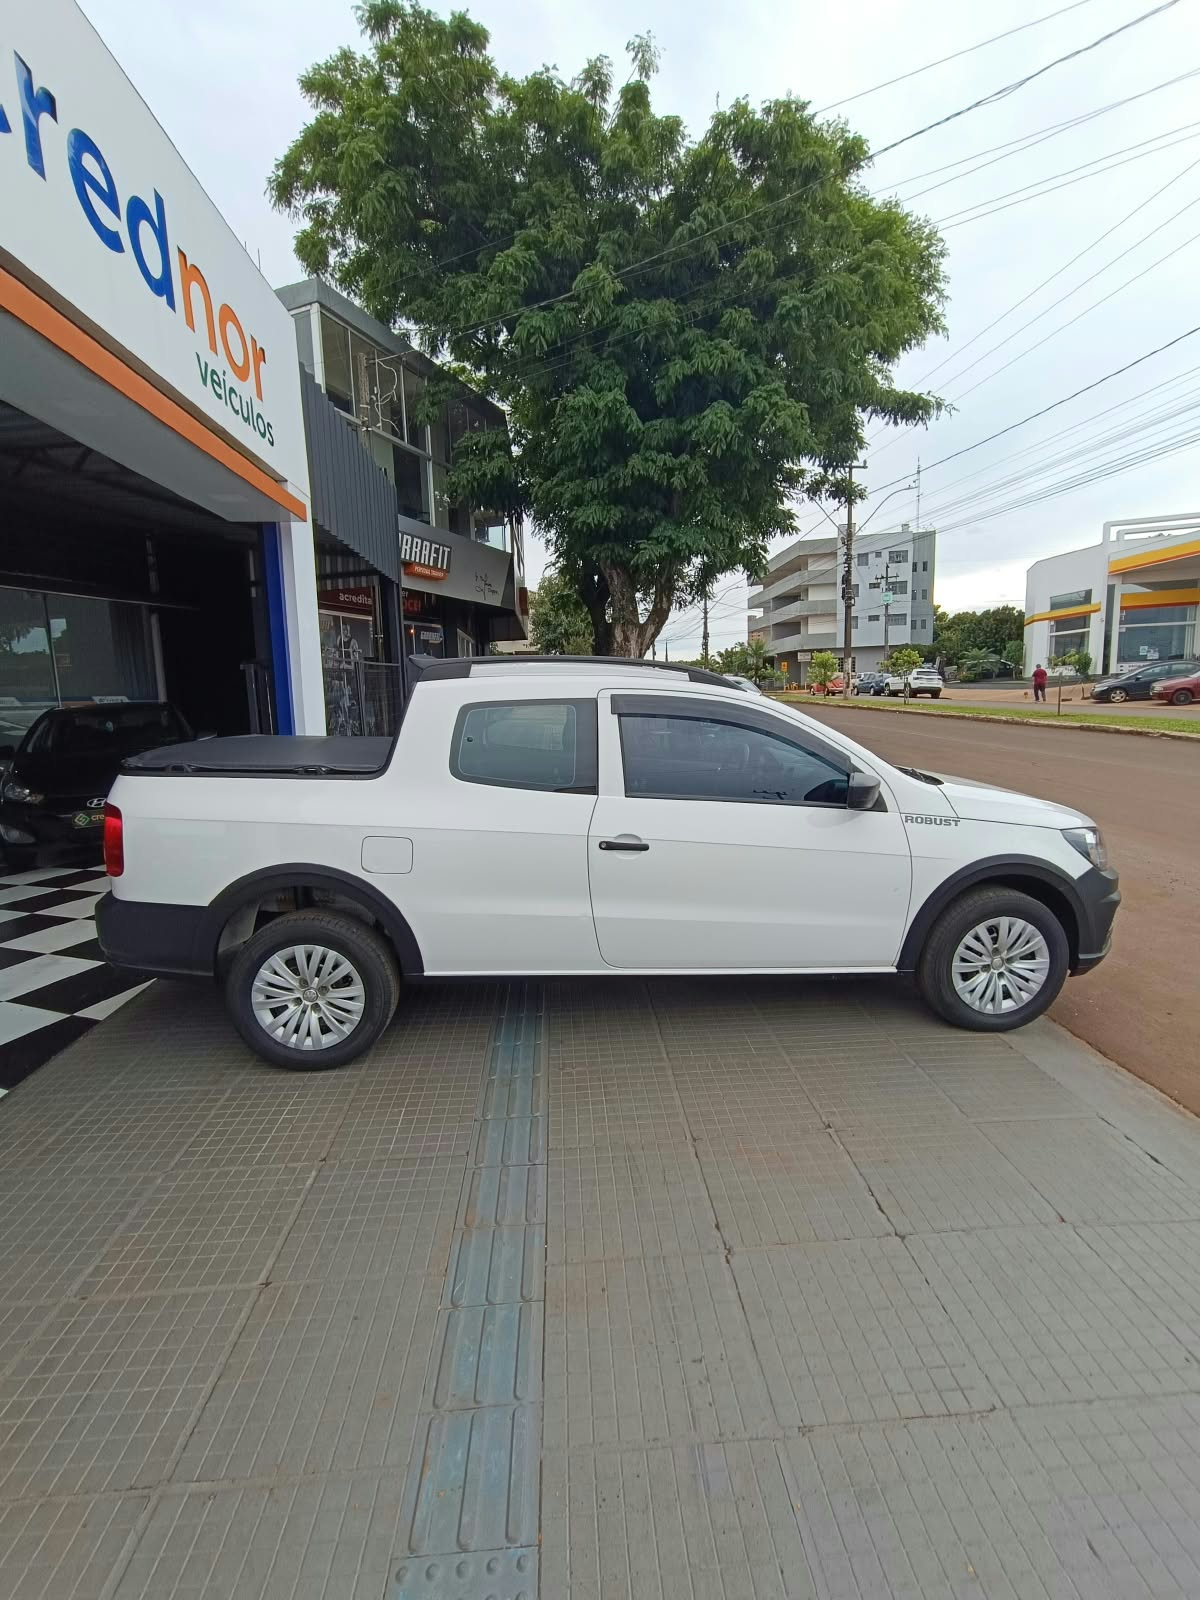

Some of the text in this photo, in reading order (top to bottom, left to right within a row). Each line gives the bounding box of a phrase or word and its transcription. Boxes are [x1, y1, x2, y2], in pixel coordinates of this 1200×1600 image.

[0, 48, 266, 402] rednor
[338, 592, 373, 604] acredita
[904, 815, 961, 827] ROBUST
